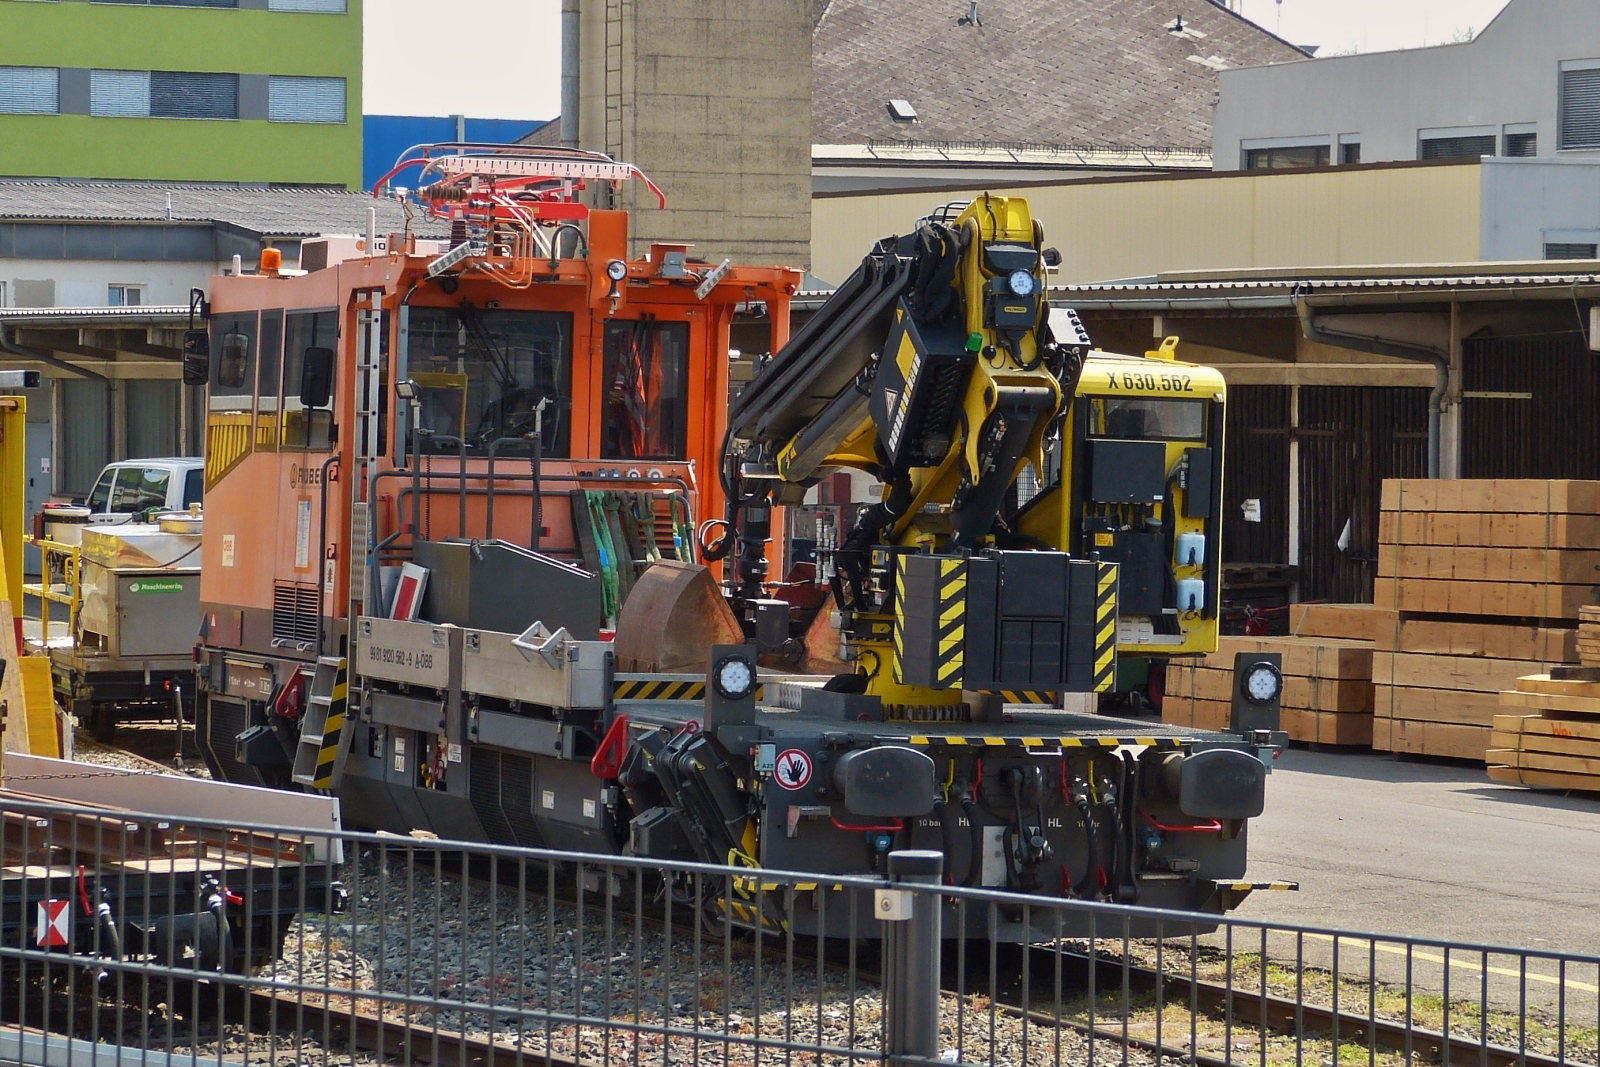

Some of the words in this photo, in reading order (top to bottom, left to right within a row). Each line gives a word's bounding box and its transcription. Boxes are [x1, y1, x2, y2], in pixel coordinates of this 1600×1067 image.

[1106, 372, 1119, 389] X
[1122, 373, 1193, 392] 630.562
[141, 583, 184, 591] Maschinenring
[1048, 818, 1063, 828] HL
